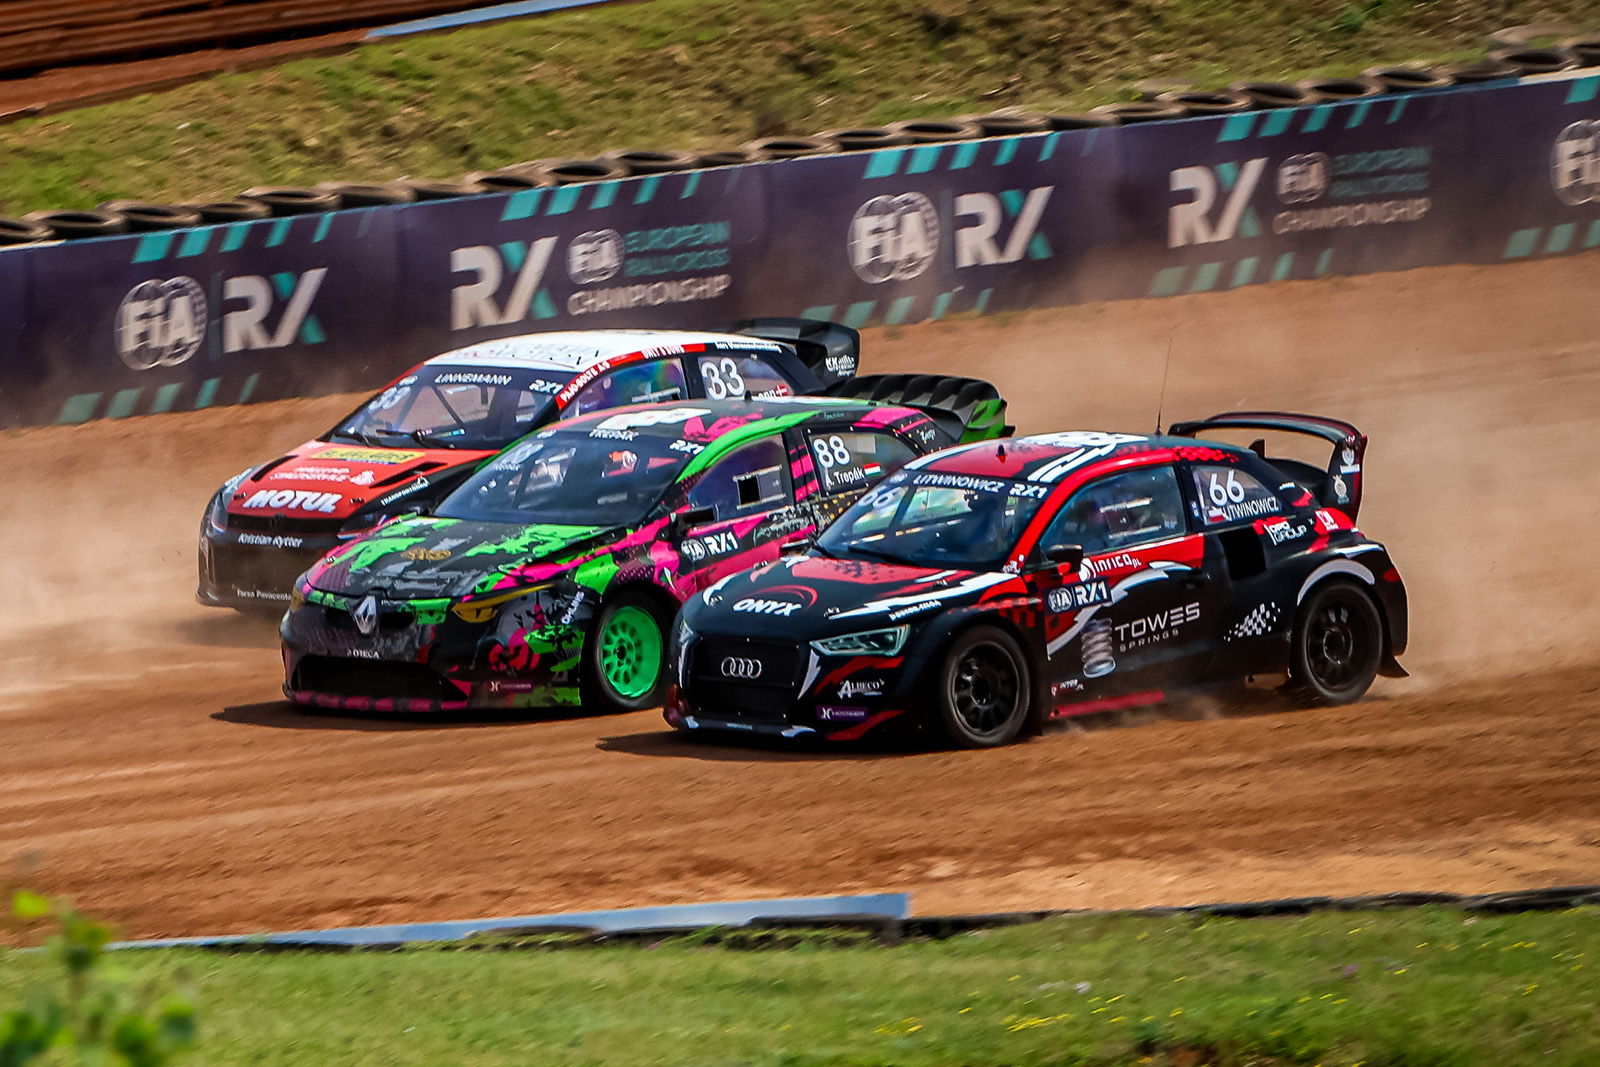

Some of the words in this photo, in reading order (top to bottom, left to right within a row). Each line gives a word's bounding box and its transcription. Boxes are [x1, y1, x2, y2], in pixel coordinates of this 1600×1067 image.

[1168, 157, 1269, 249] RX
[954, 185, 1055, 269] RX
[450, 236, 559, 331] RX
[223, 267, 329, 353] RX
[813, 435, 850, 468] 88
[913, 474, 1005, 493] LITWINOWICZ
[1009, 482, 1048, 499] RX1
[1209, 469, 1245, 507] 66
[243, 489, 343, 513] MOTUL
[704, 532, 738, 555] RX1
[733, 598, 802, 617] ONYX
[1075, 581, 1108, 606] RX1
[1114, 601, 1200, 641] TOWES
[1119, 628, 1179, 653] SPRINGS
